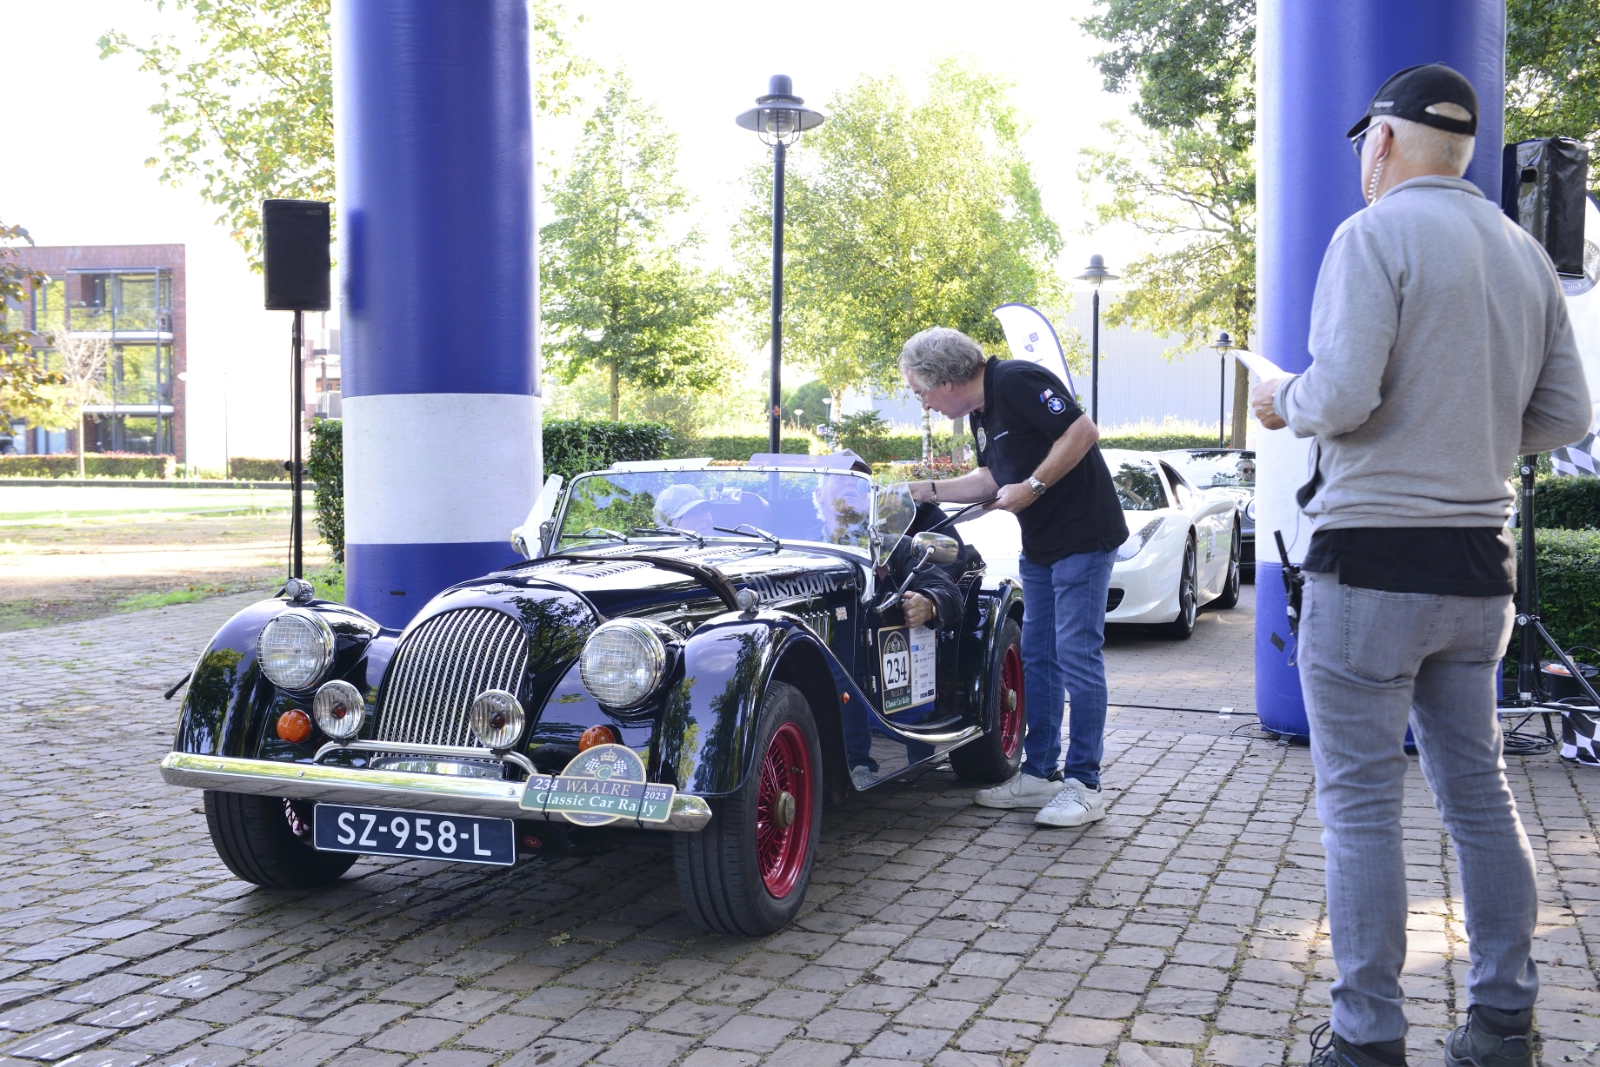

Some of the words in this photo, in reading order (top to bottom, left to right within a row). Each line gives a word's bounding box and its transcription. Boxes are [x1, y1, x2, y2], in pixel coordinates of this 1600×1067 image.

[742, 572, 838, 608] Morgan
[887, 656, 907, 684] 234
[533, 778, 559, 791] 234
[566, 780, 632, 797] WAALRE
[643, 791, 667, 801] 2023
[536, 792, 585, 807] Classic
[589, 796, 615, 809] Car
[337, 812, 492, 857] SZ-958-L
